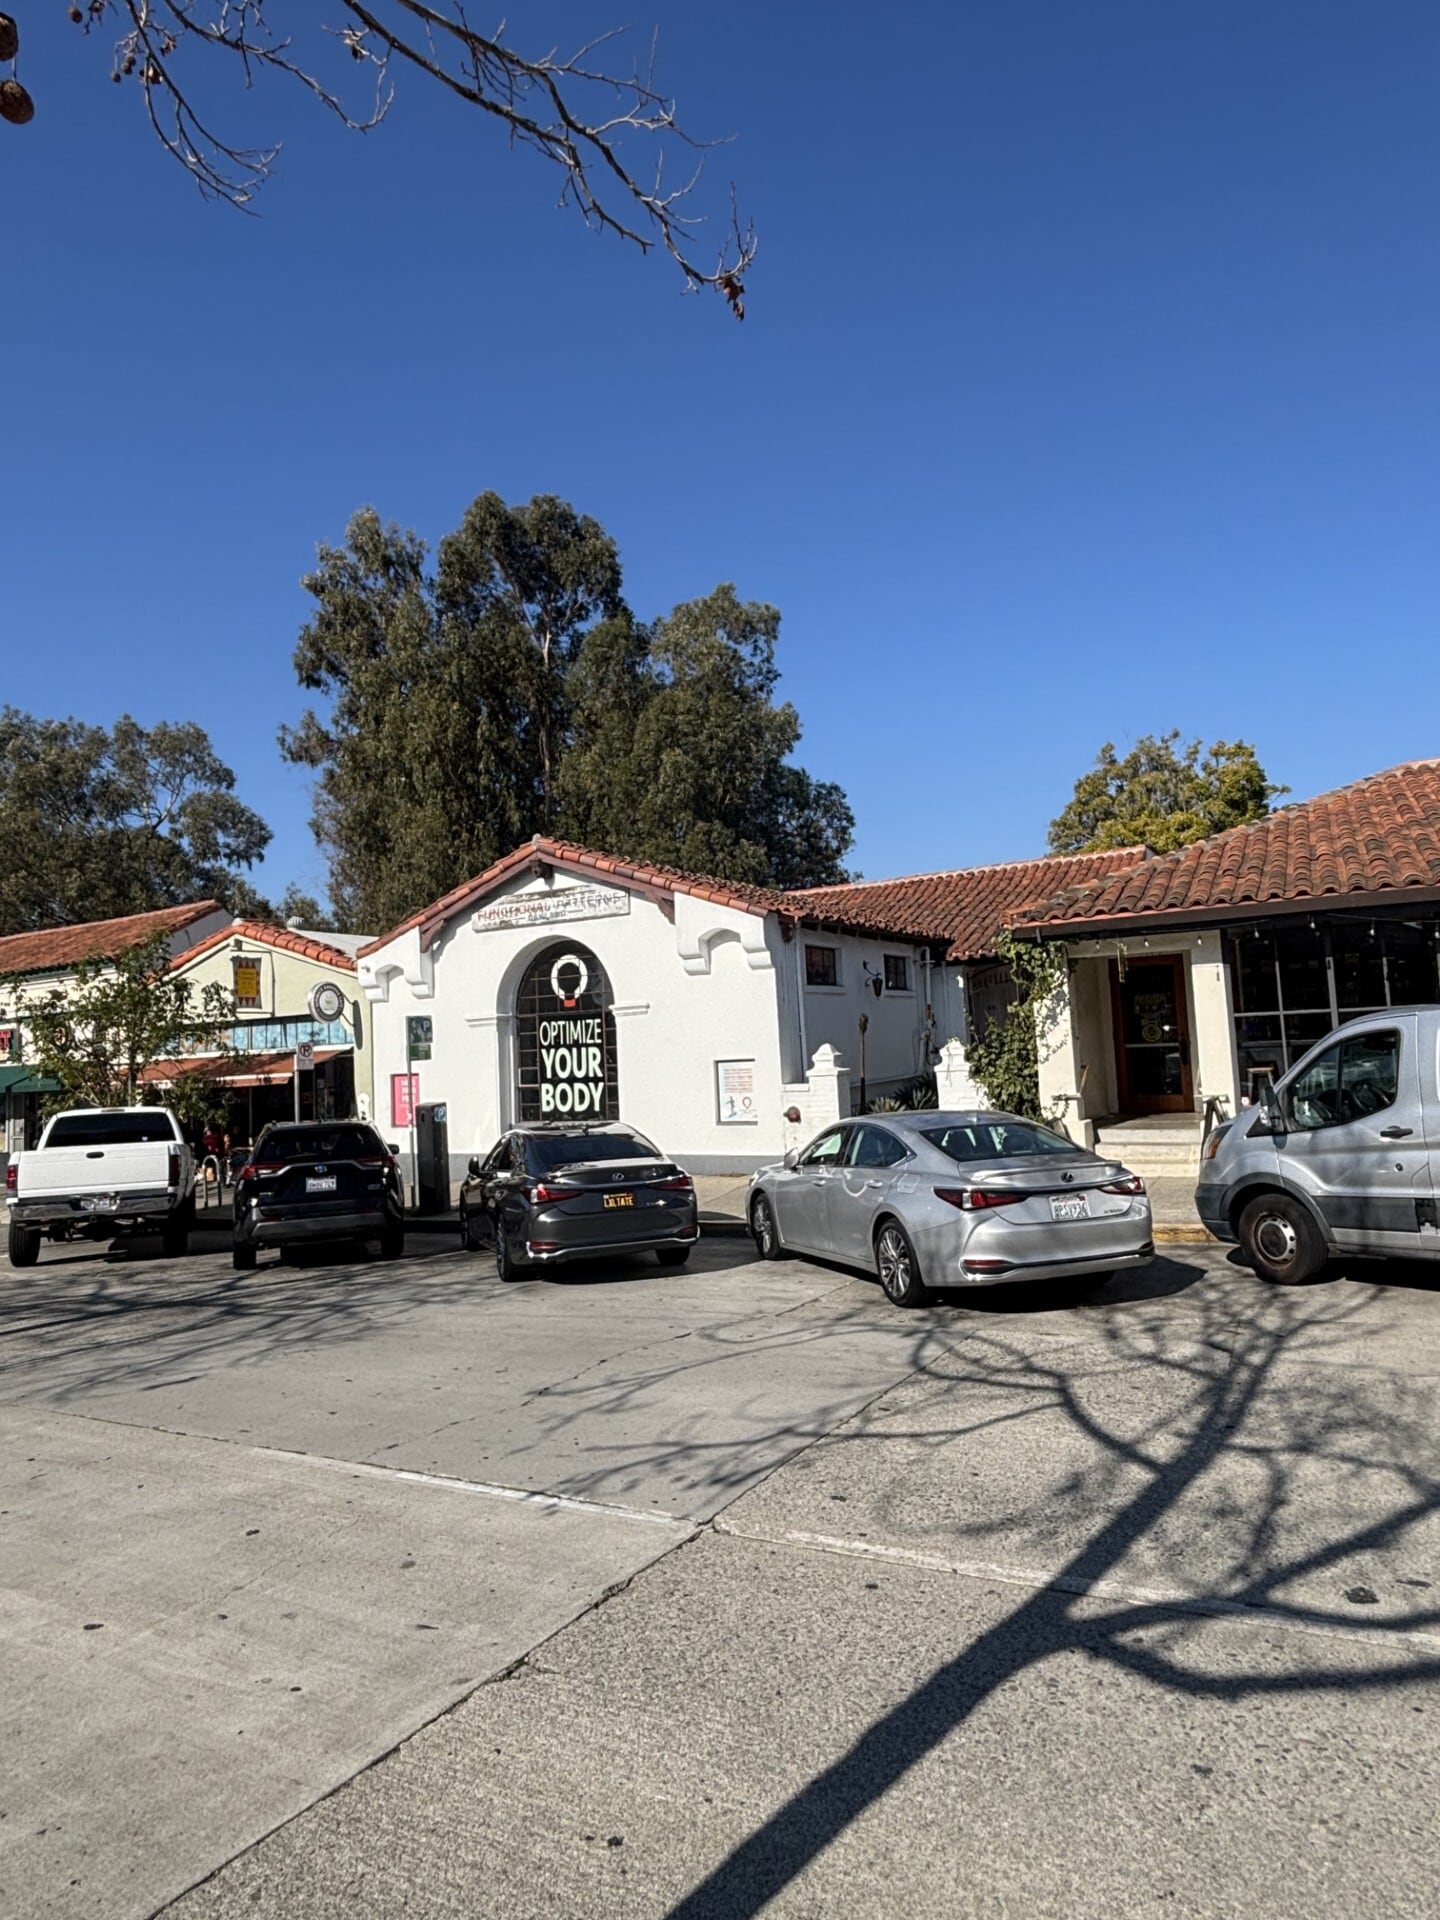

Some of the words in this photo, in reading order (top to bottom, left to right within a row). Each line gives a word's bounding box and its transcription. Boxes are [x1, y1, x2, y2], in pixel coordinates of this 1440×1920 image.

[556, 892, 621, 910] PATTERNS
[539, 1019, 602, 1046] OPTIMIZE
[541, 1047, 603, 1079] YOUR
[541, 1082, 604, 1113] BODY
